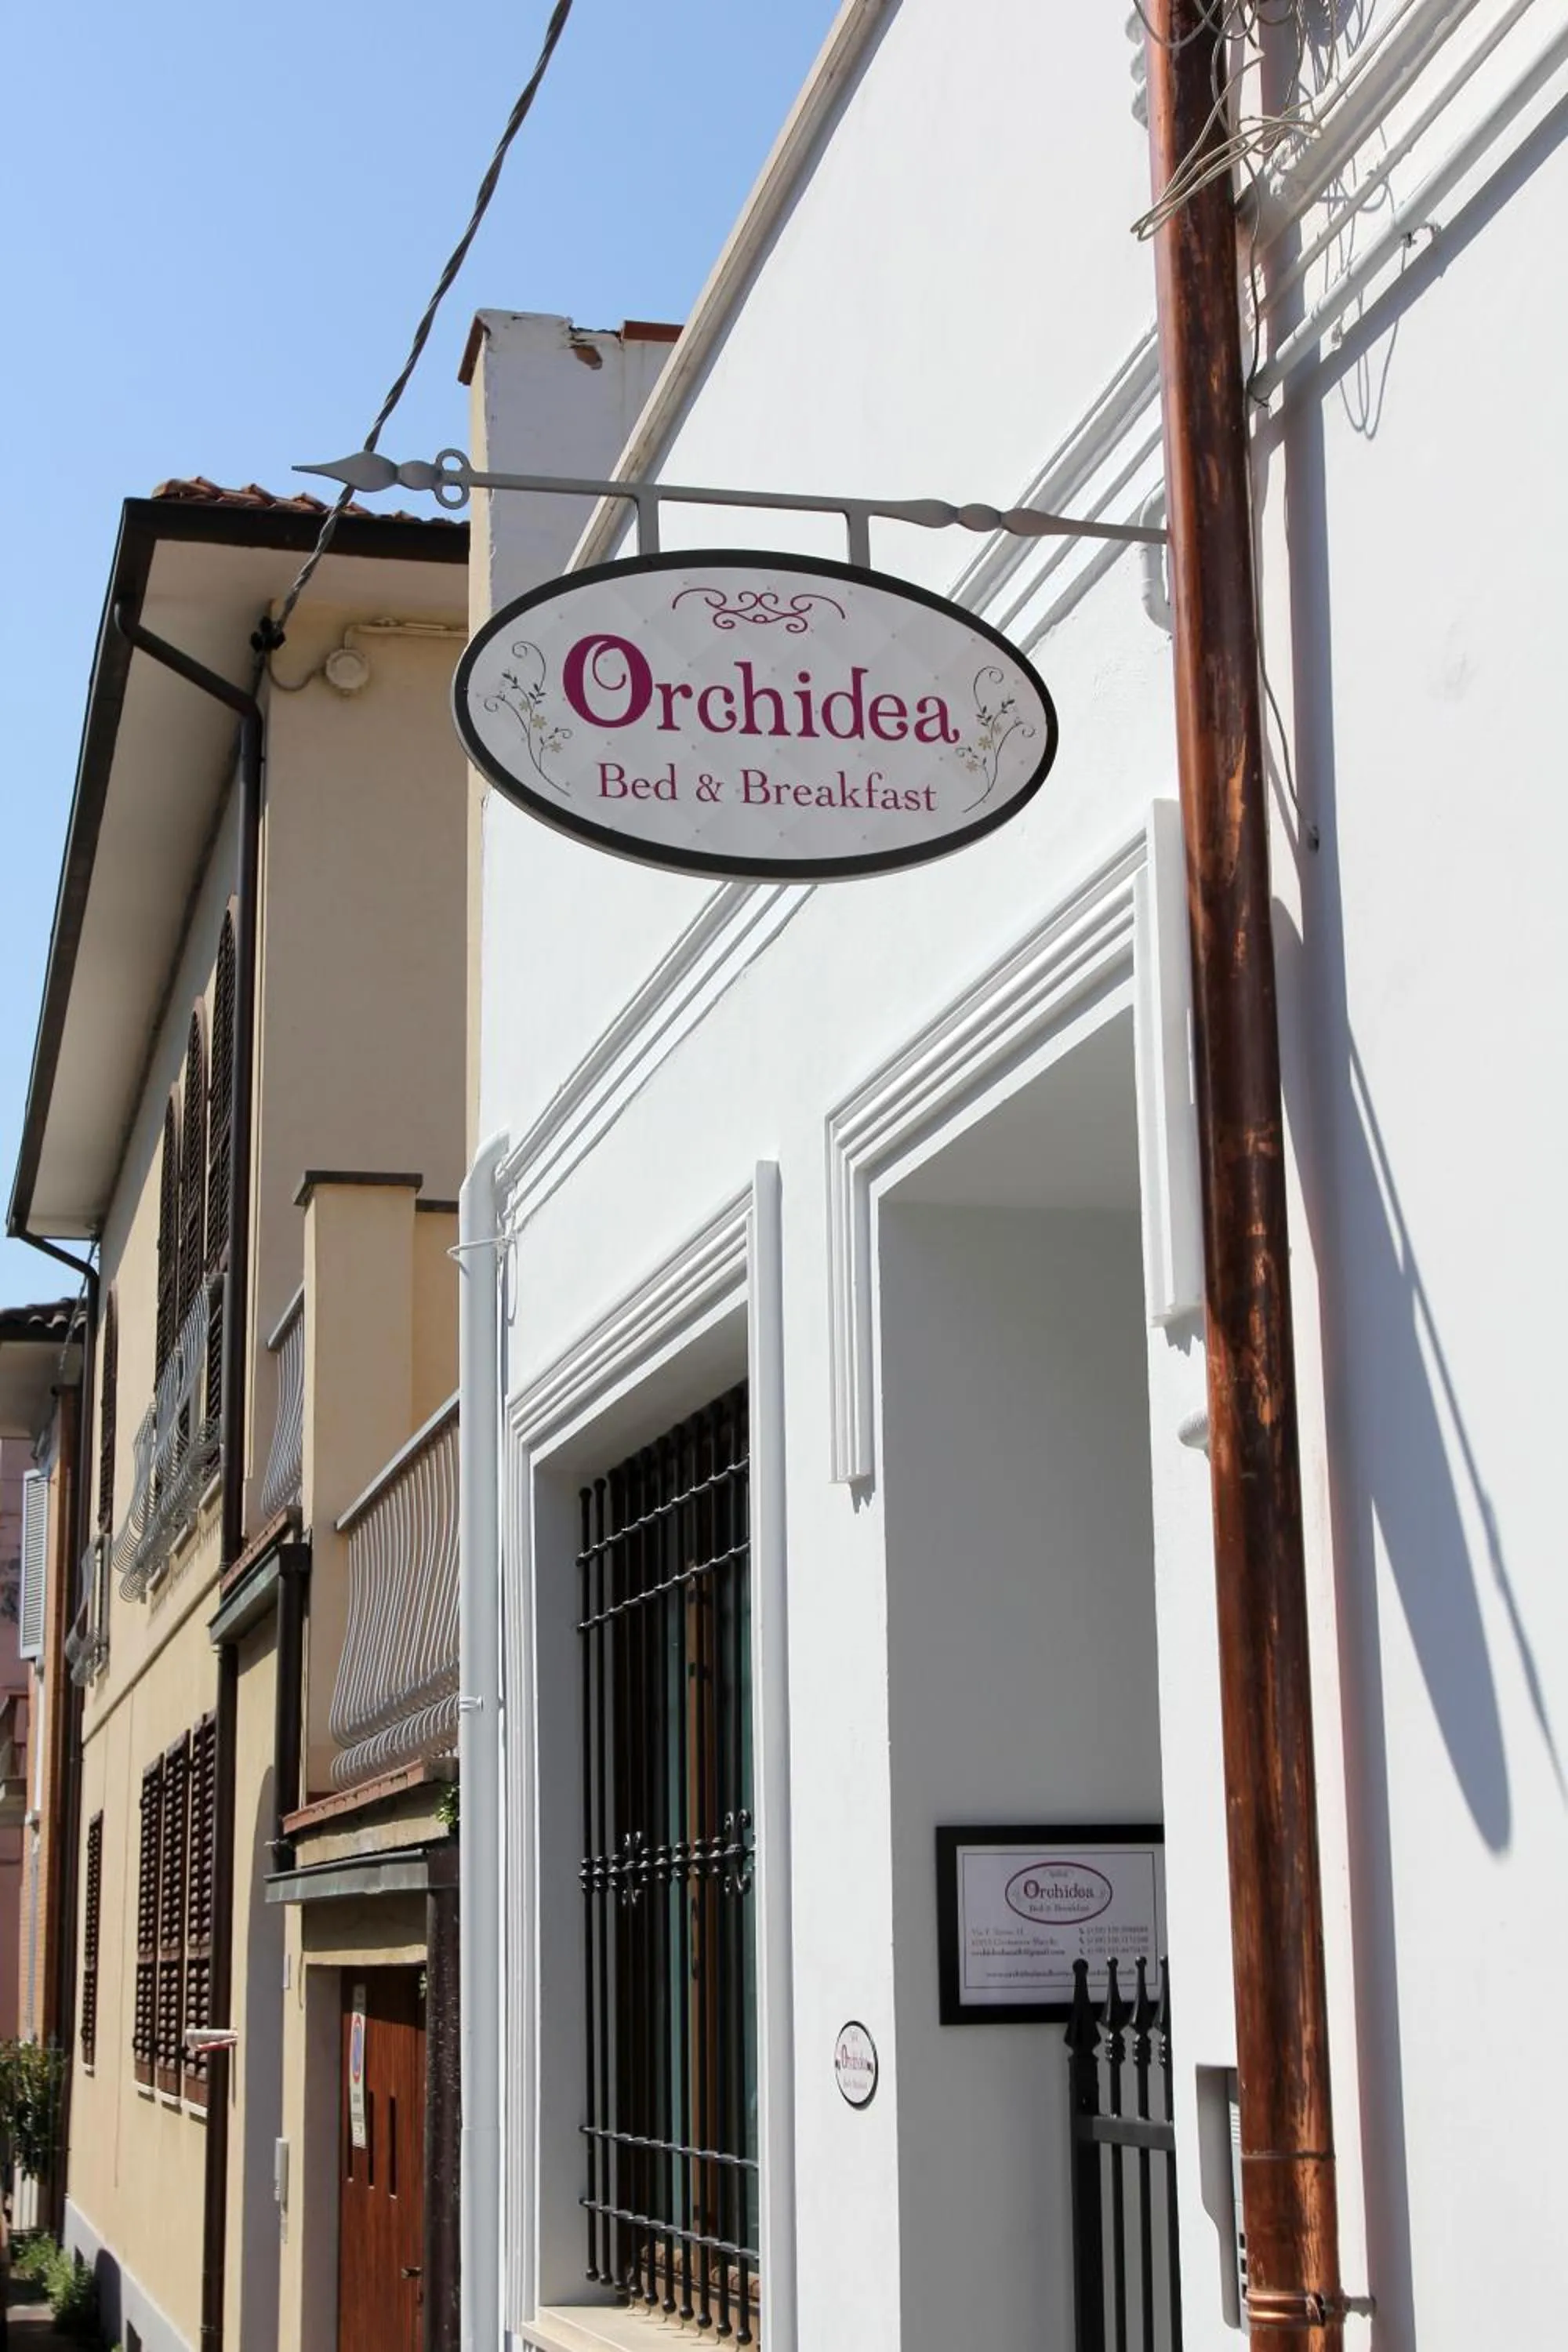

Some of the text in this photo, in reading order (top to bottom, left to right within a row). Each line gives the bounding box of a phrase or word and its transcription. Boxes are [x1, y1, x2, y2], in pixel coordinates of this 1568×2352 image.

[562, 633, 960, 743] Orchidea
[597, 762, 938, 811] Bed & Breakfast
[1023, 1879, 1094, 1900] Orchidea
